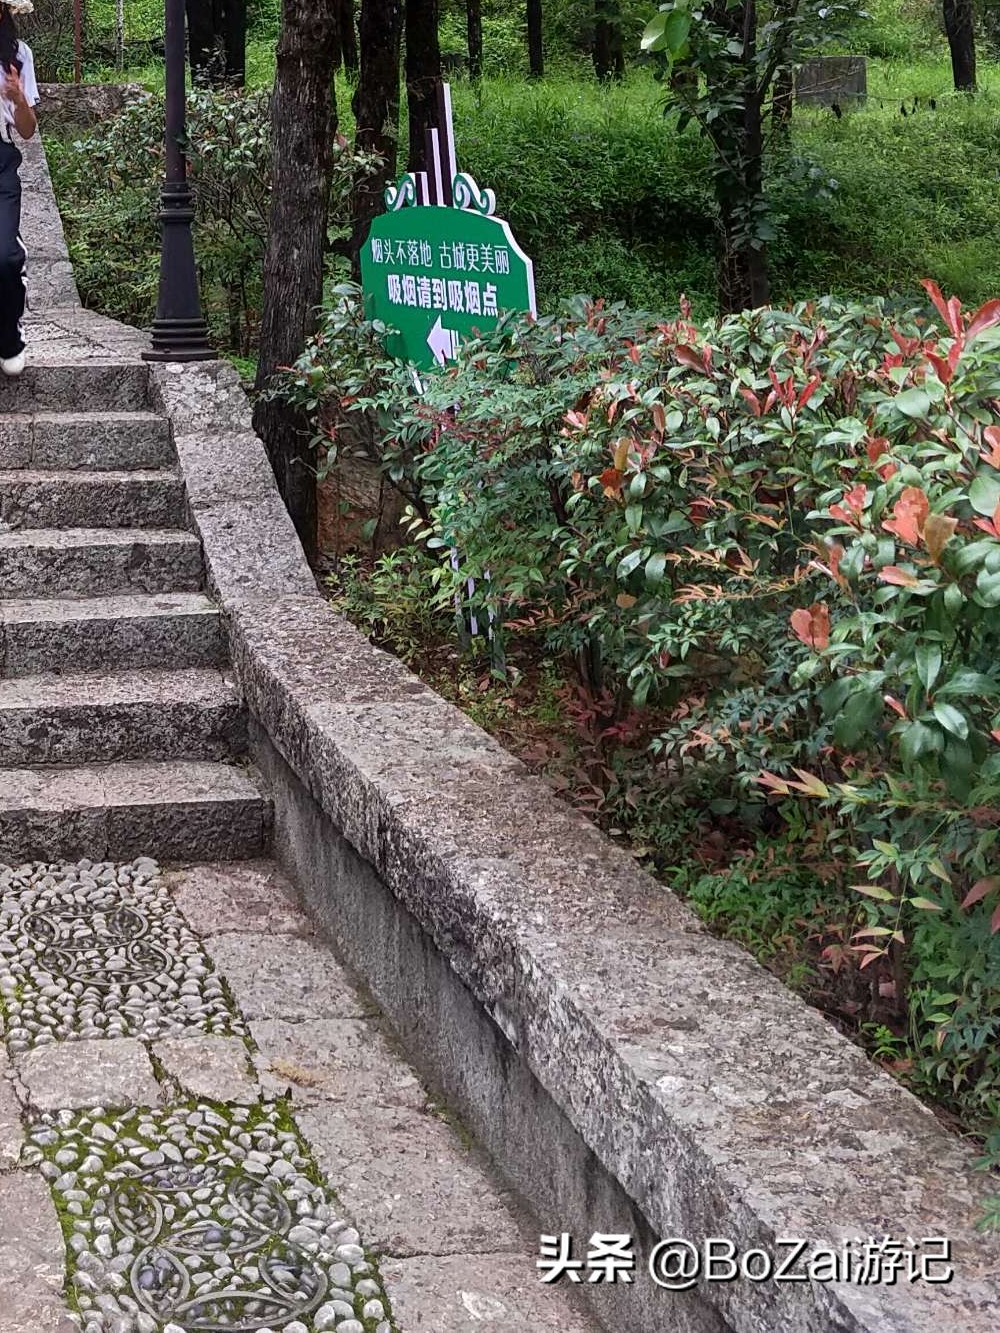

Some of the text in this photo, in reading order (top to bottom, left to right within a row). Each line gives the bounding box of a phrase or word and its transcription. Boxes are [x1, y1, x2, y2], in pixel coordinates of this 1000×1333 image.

[371, 237, 510, 275] 烟头不落地 古城更美丽
[387, 274, 499, 318] 吸烟请到吸烟点
